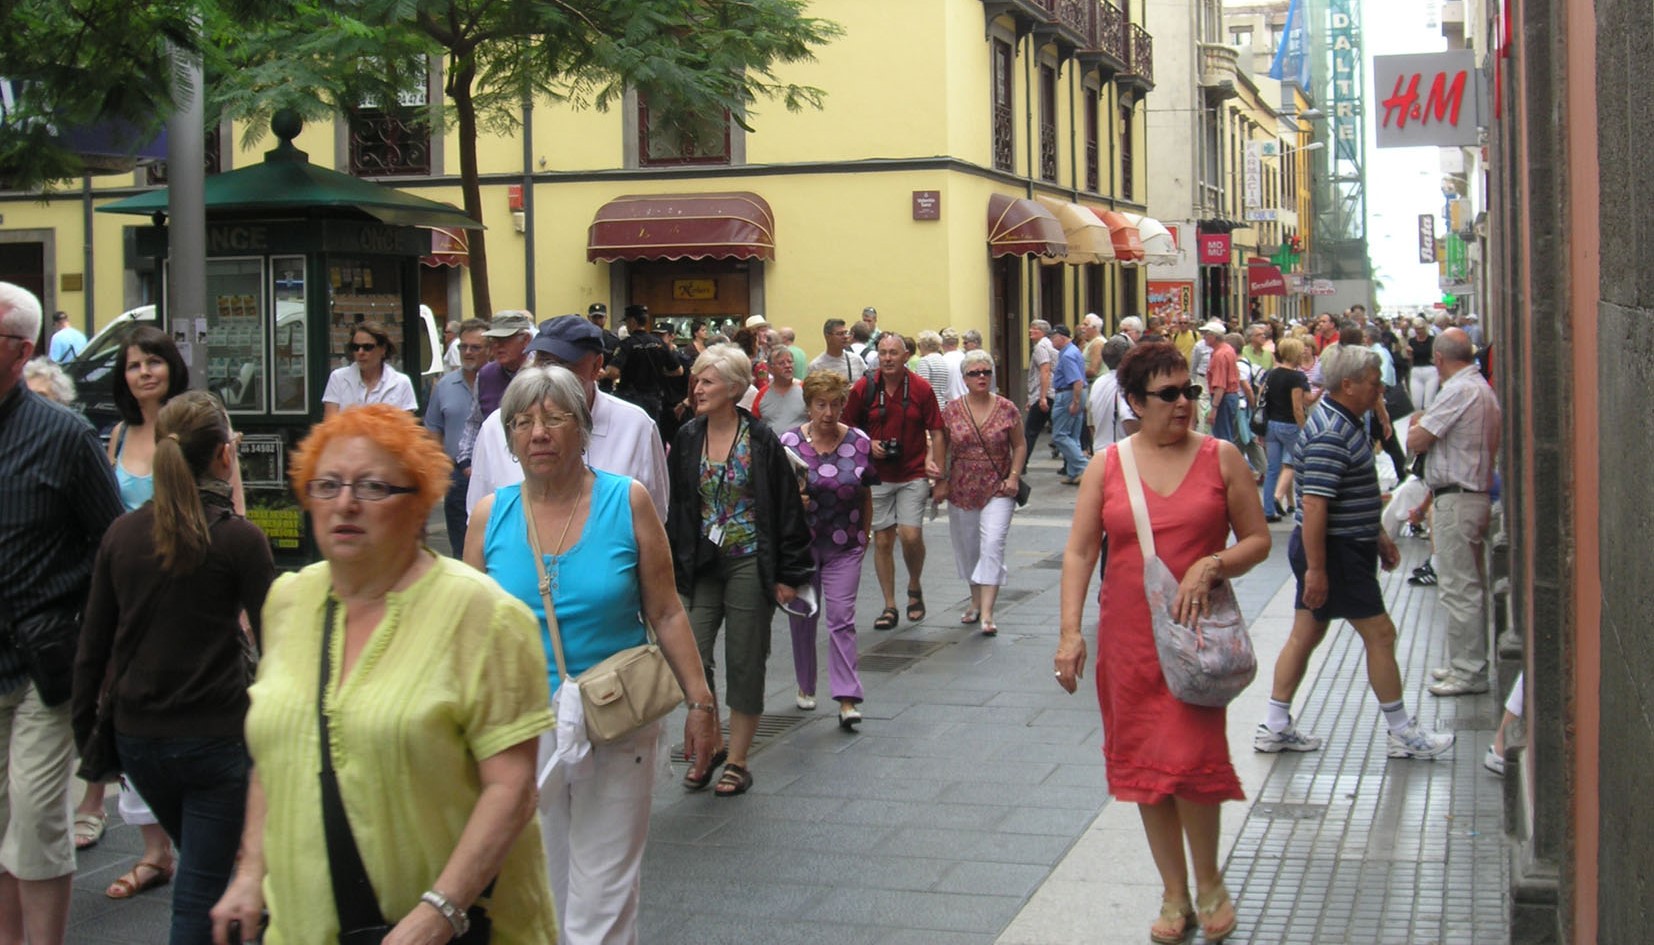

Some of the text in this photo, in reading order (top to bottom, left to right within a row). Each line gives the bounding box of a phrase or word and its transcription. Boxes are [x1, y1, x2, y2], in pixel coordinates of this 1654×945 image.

[1332, 13, 1354, 140] DALTRE
[1381, 69, 1468, 129] H&M
[206, 226, 268, 250] NCE
[1420, 216, 1434, 262] Bata
